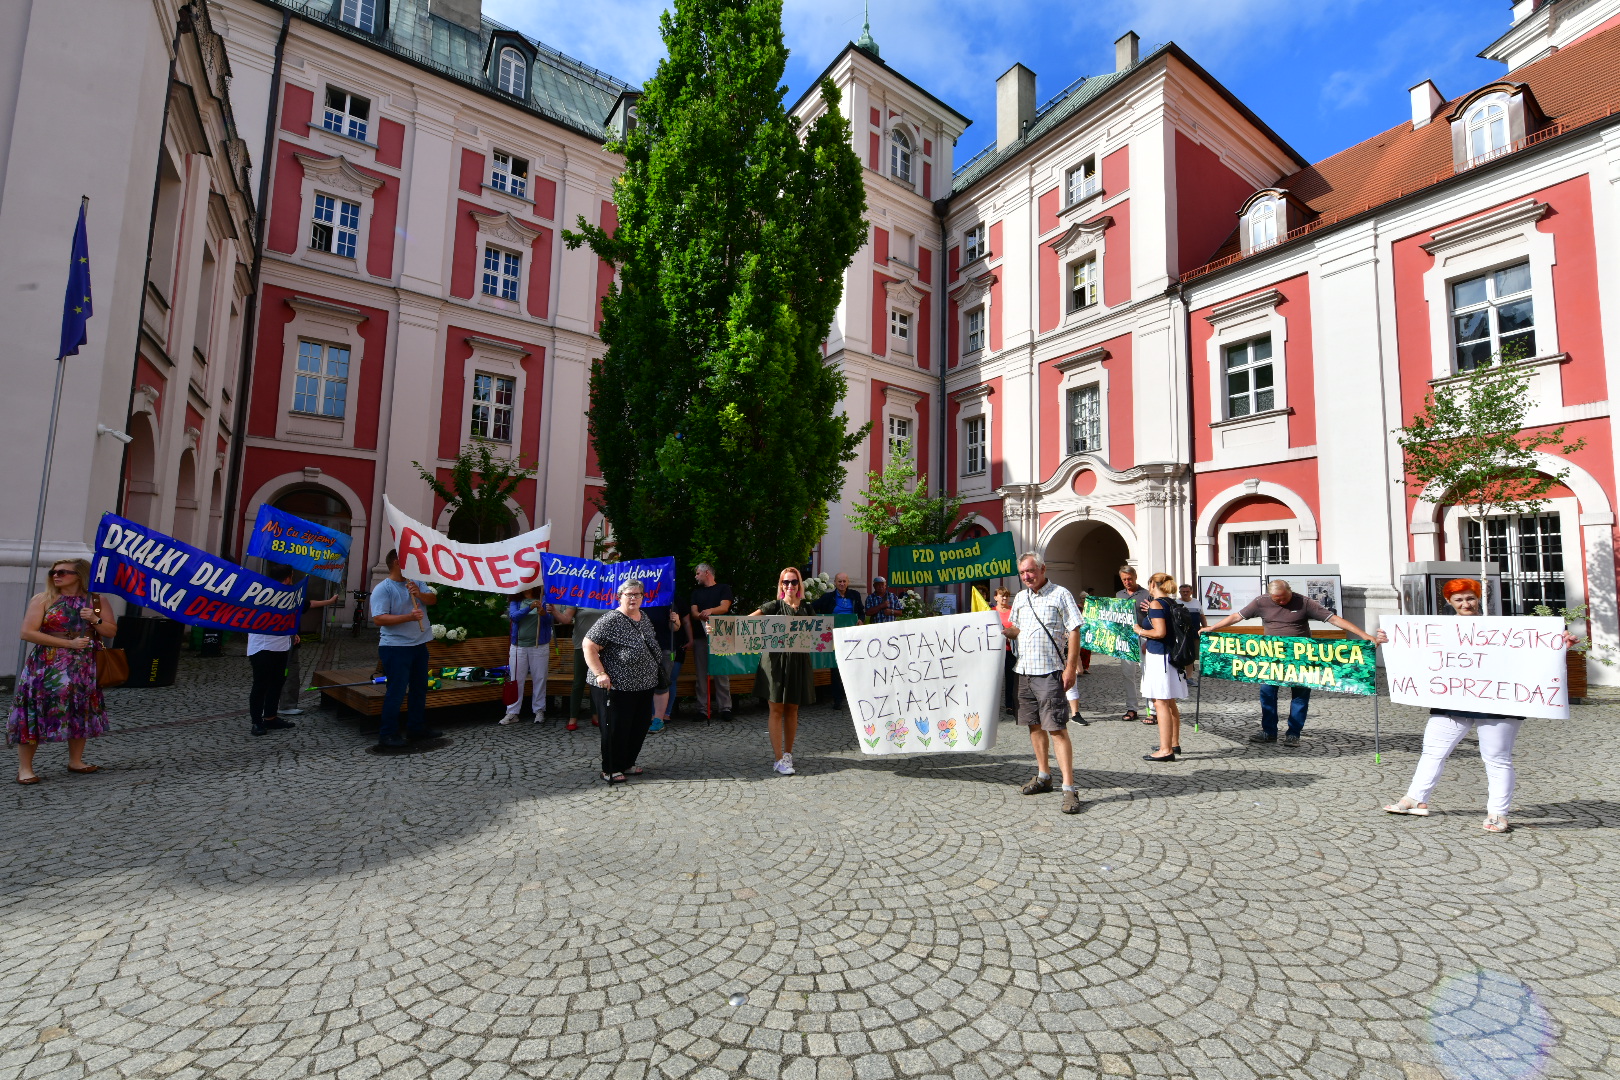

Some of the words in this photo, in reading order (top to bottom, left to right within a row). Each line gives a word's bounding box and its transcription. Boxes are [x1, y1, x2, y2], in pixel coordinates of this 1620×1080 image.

[261, 520, 283, 537] My
[286, 526, 299, 538] tu
[301, 530, 337, 547] żyjemy
[102, 523, 190, 577] DZIAŁKI
[189, 561, 238, 597] DLA
[271, 539, 308, 555] 83,300
[309, 546, 321, 561] kg
[912, 548, 935, 563] PZD
[939, 541, 981, 565] ponad
[94, 556, 109, 584] A
[113, 562, 147, 598] NIE
[150, 578, 187, 612] DLA
[547, 558, 597, 580] Działek
[599, 571, 615, 583] nie
[618, 565, 663, 582] oddamy
[891, 569, 933, 585] MILION
[936, 557, 1012, 583] WYBORCÓW
[550, 585, 568, 599] my
[570, 584, 585, 598] tu
[1207, 635, 1287, 659] ZIELONE
[1293, 642, 1365, 665] PŁUCA
[1455, 622, 1566, 651] WSZYSTKO
[149, 658, 160, 682] PLASTIK
[873, 656, 958, 688] NASZE
[1231, 658, 1337, 687] POZNANIA
[1428, 650, 1489, 672] JEST
[1392, 676, 1419, 697] NA
[1429, 676, 1565, 708] SPRZEDAŻ
